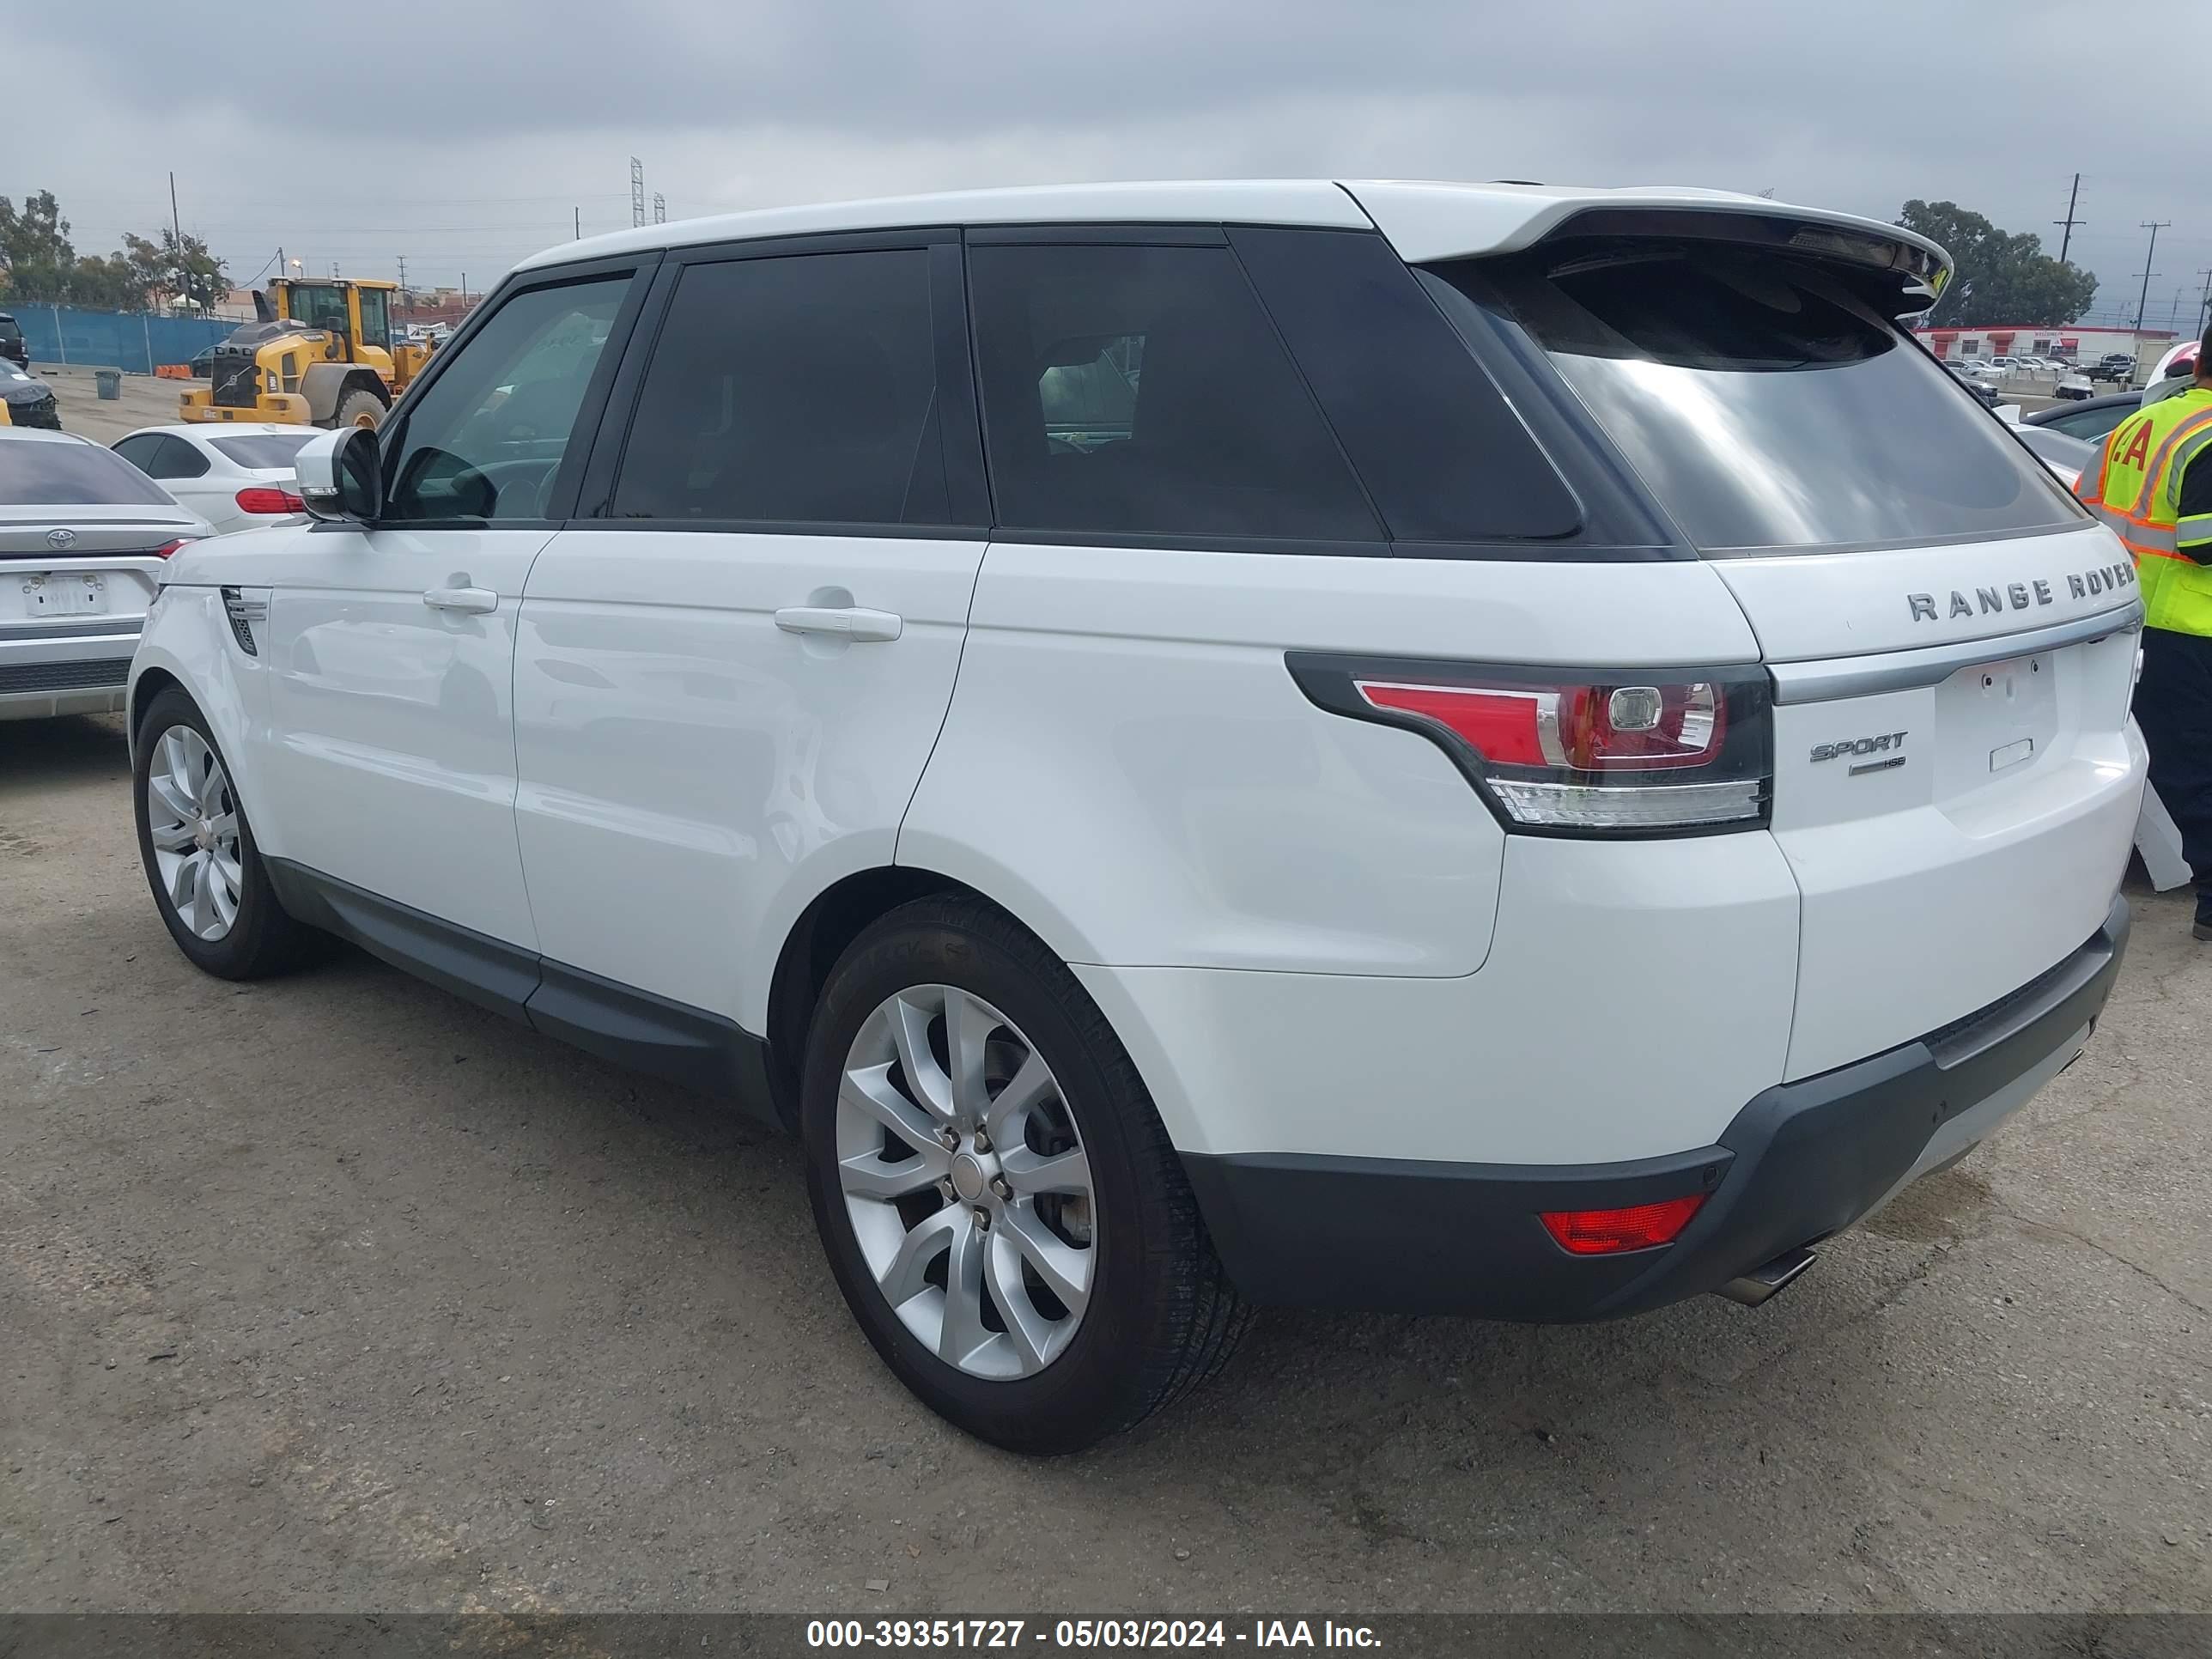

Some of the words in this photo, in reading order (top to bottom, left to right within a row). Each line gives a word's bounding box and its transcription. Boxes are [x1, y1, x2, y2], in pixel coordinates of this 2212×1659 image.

[1907, 579, 2053, 622] RANGE
[2067, 562, 2135, 599] ROVER
[1809, 731, 1909, 763] SPORT
[1884, 756, 1906, 769] HSE
